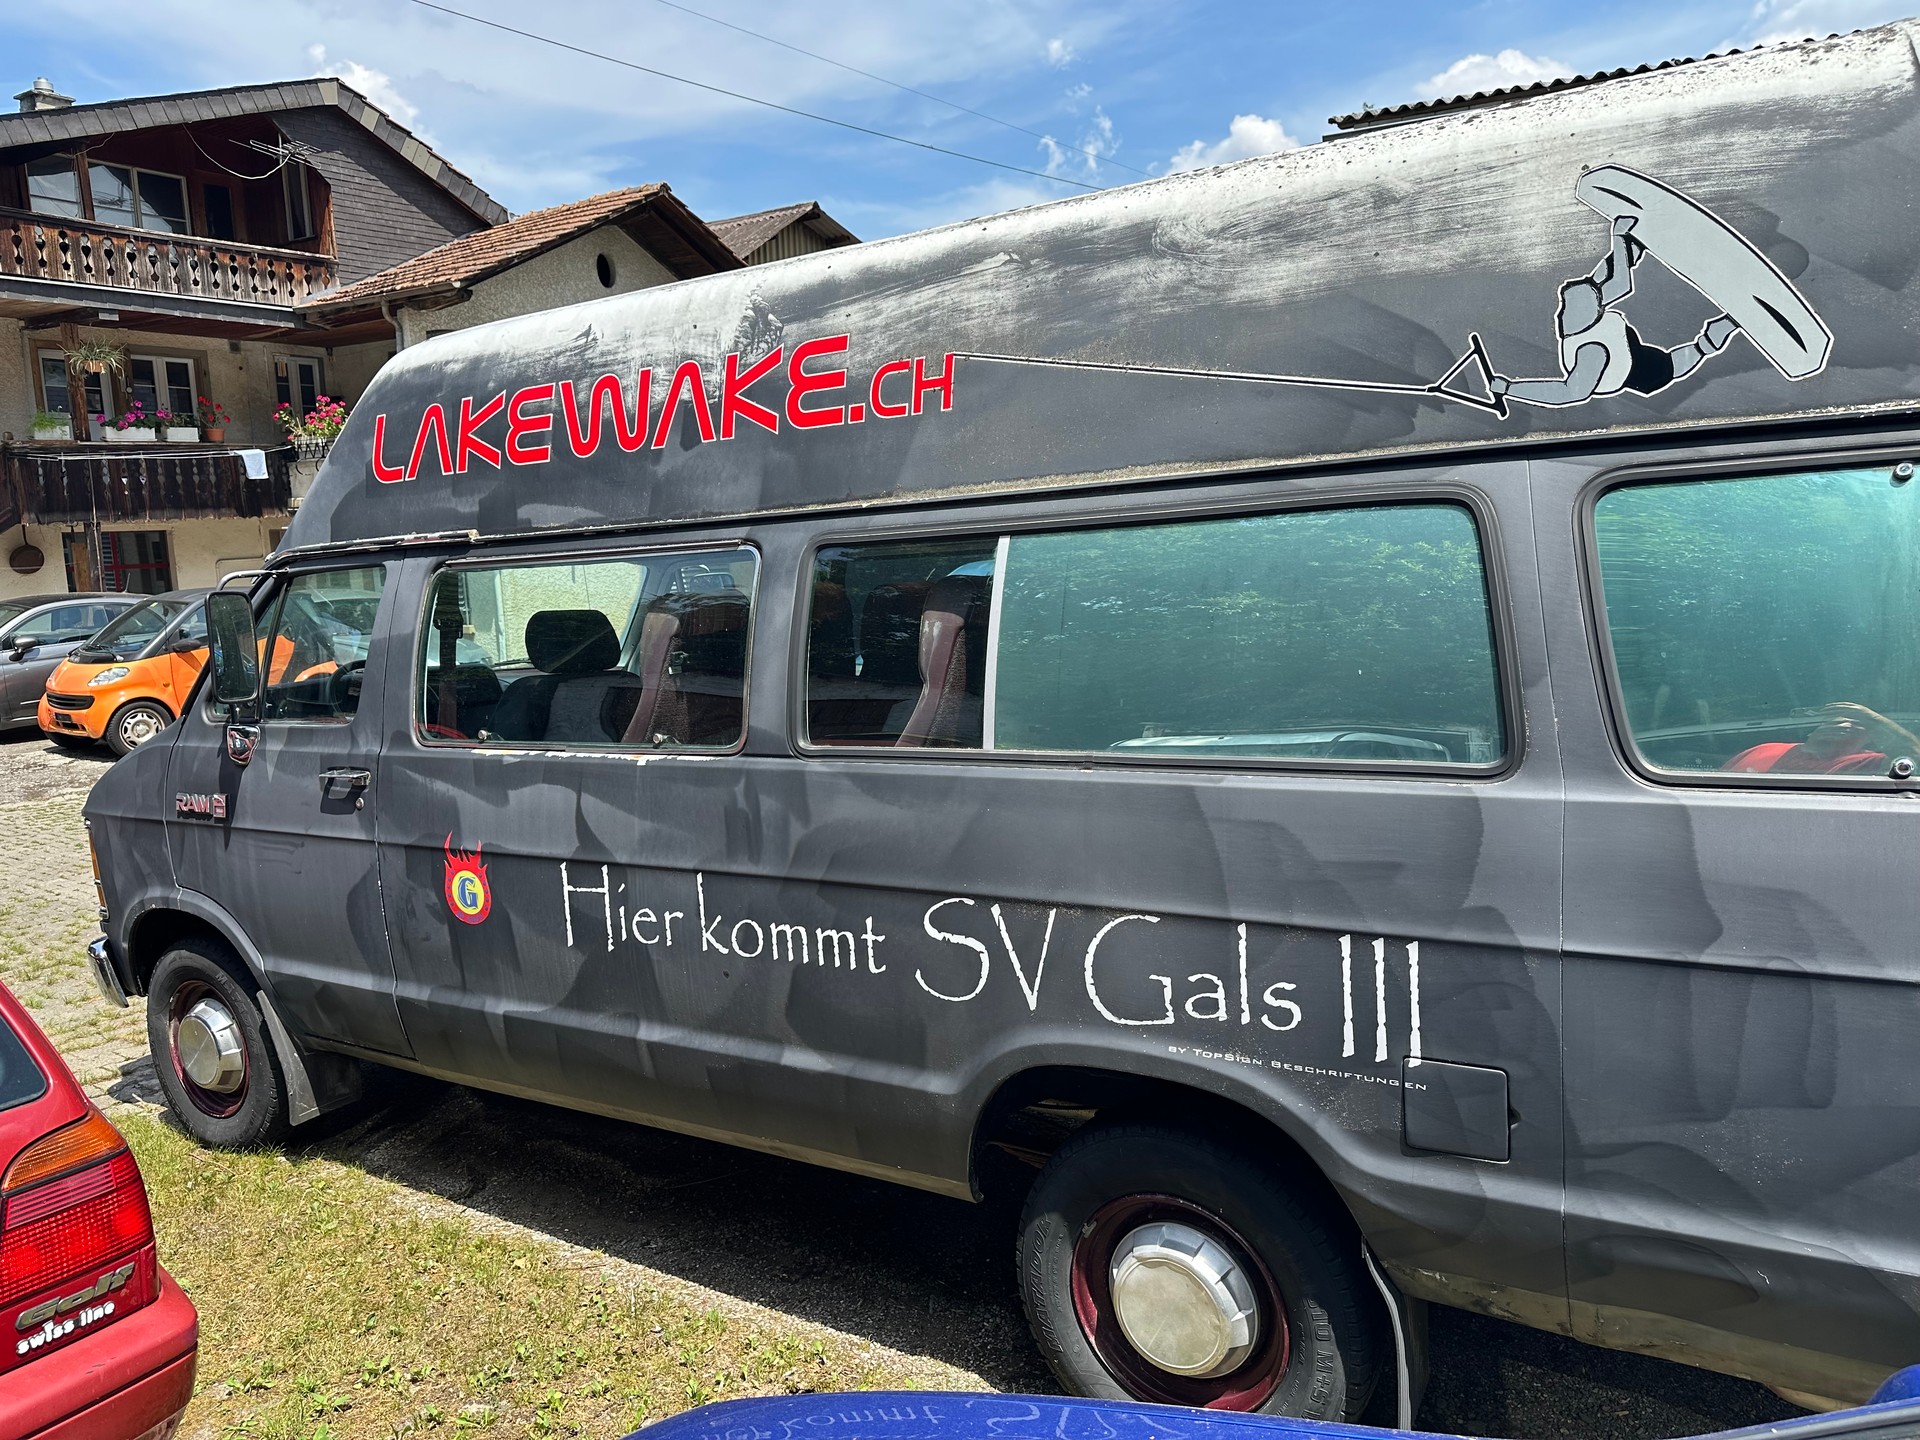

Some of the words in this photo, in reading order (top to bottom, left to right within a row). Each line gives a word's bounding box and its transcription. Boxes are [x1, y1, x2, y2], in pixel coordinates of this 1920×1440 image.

[372, 332, 955, 485] LAKEWAKE.CH
[176, 792, 212, 813] RAM
[458, 876, 479, 909] G
[560, 861, 684, 952] Hier
[696, 872, 887, 974] kommt
[915, 897, 1056, 1011] SV
[1084, 915, 1302, 1031] Gals
[1168, 1045, 1187, 1054] BY
[1271, 1060, 1428, 1091] BESCHRIFTUNGEN
[15, 1261, 135, 1330] Golf
[16, 1319, 75, 1355] swiss
[79, 1300, 115, 1327] line
